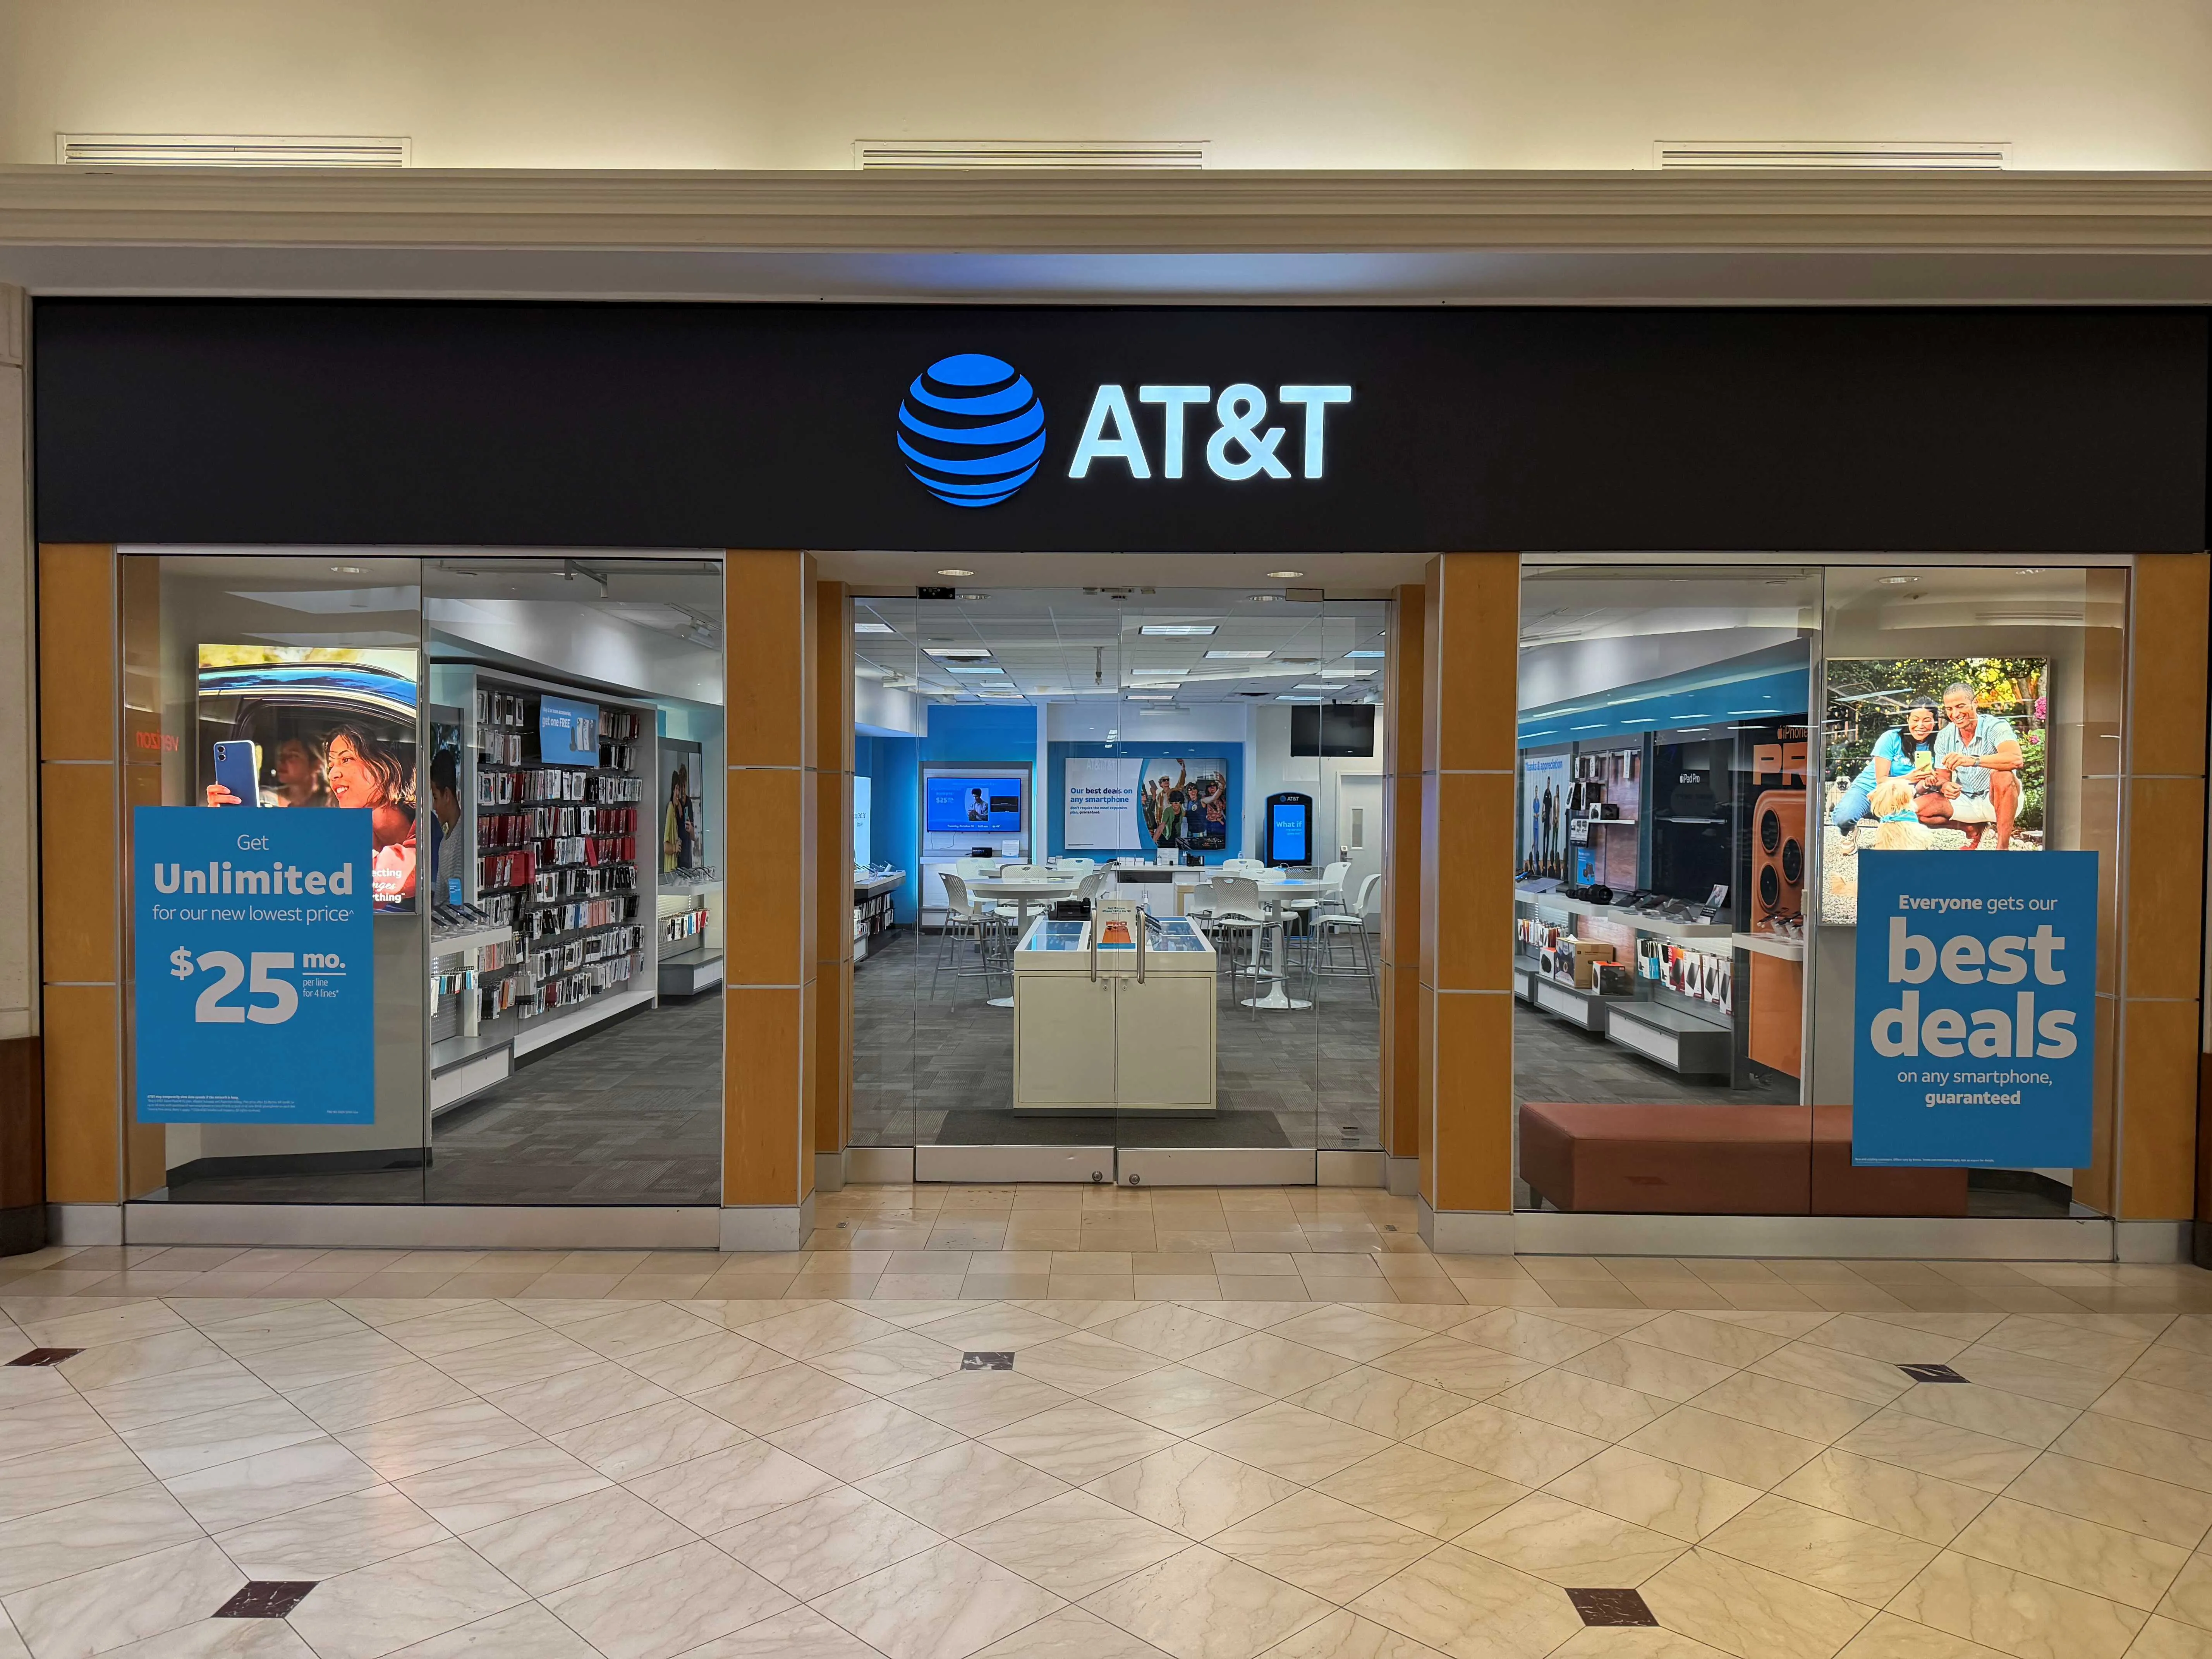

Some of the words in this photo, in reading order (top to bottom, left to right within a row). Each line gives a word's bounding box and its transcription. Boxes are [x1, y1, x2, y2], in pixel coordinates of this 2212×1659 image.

[1068, 384, 1352, 481] AT&T
[550, 718, 559, 727] one
[1783, 725, 1808, 739] iPhone
[1683, 773, 1692, 783] iPad
[237, 835, 269, 850] Get
[155, 862, 352, 895] Unlimited
[1899, 895, 1982, 913] Everyone
[1987, 896, 2024, 914] gets
[2029, 899, 2058, 910] our
[153, 905, 176, 920] for
[180, 909, 208, 920] our
[211, 909, 246, 921] new
[249, 905, 302, 921] lowest
[1889, 917, 2066, 985] best
[303, 953, 345, 969] mo.
[170, 946, 298, 1024] $25
[303, 980, 314, 988] per
[316, 978, 328, 986] line
[303, 988, 313, 997] for
[314, 989, 319, 997] 4
[1870, 991, 2077, 1058] deals
[1898, 1072, 1917, 1082] on
[1922, 1072, 1949, 1086] any
[1953, 1069, 2052, 1087] smartphone,
[1925, 1091, 2021, 1108] guaranteed
